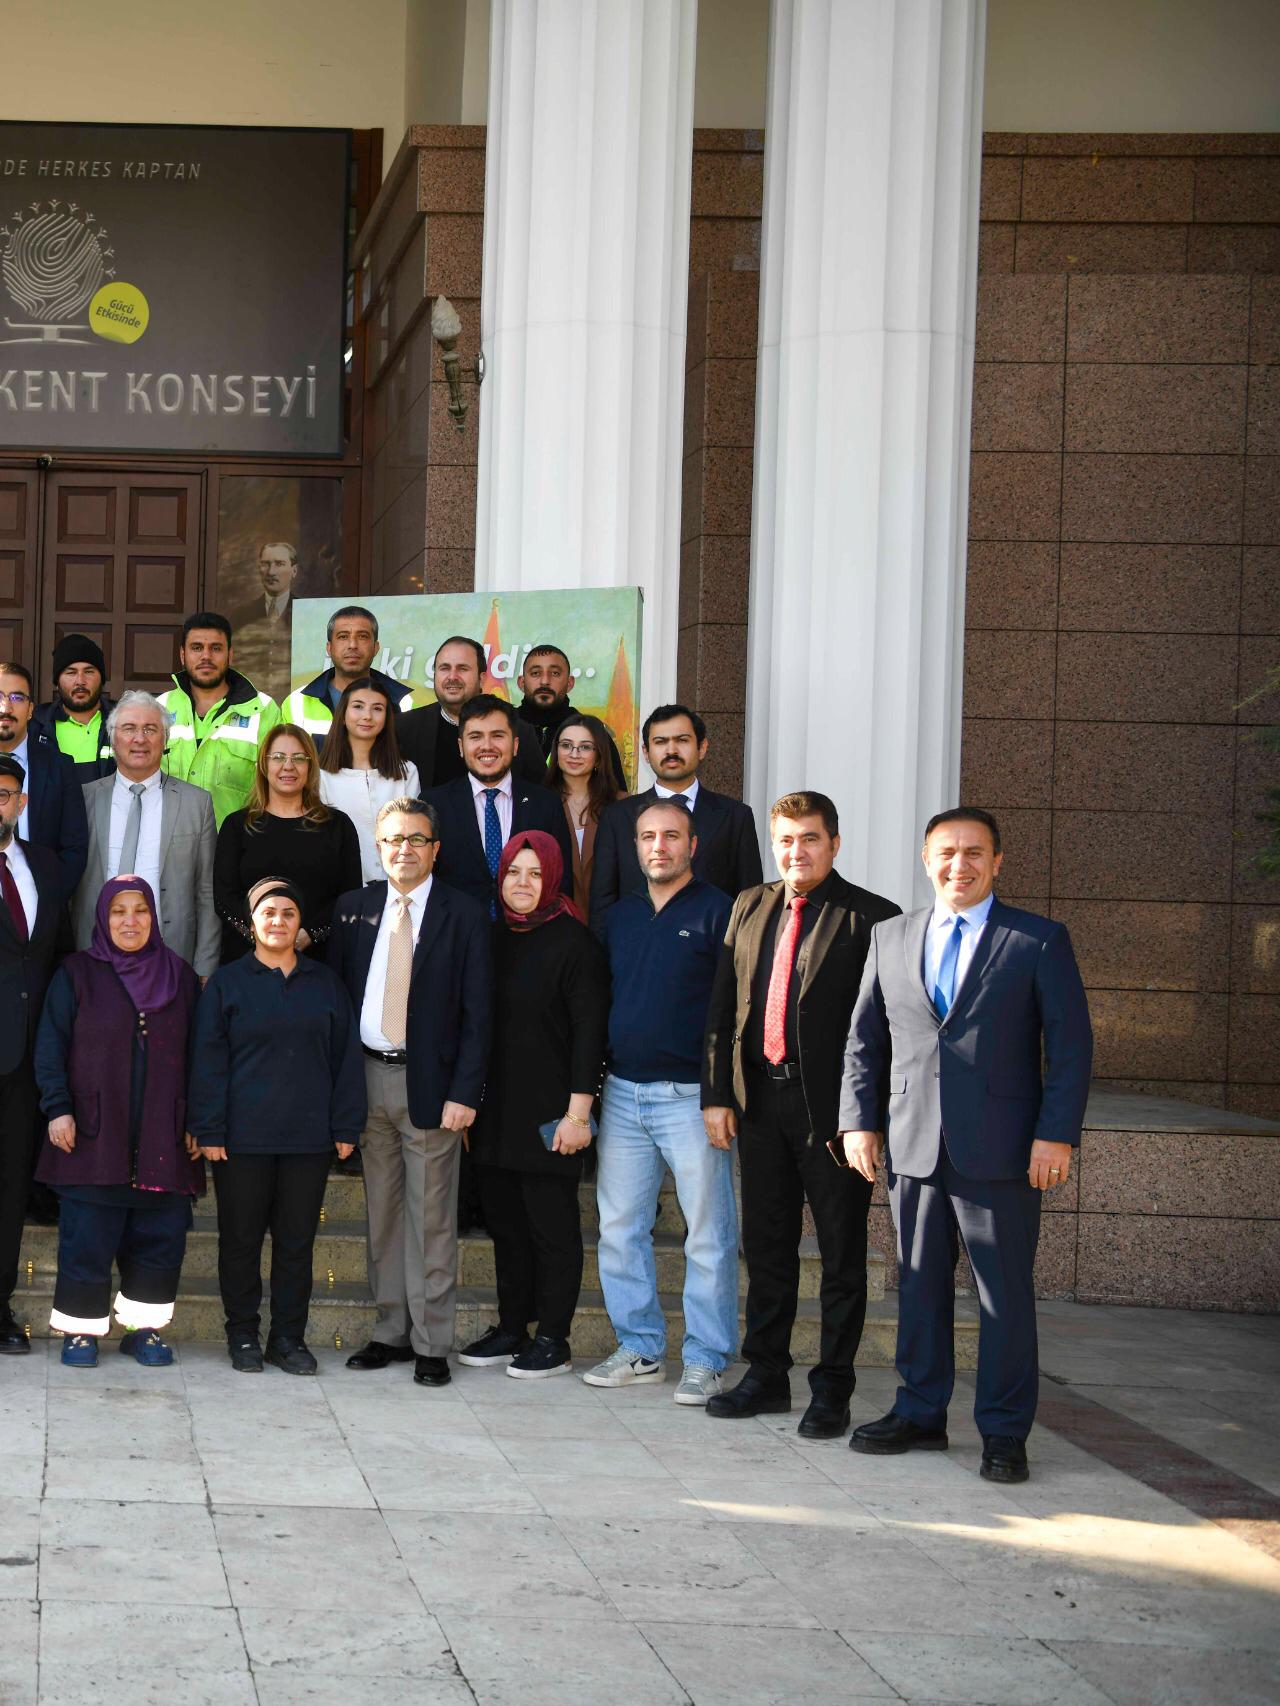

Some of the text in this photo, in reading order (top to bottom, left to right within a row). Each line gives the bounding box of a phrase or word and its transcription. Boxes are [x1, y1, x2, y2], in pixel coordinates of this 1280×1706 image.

[38, 160, 112, 178] HERKES
[122, 162, 201, 180] KAPTAN
[96, 305, 141, 328] Etkisinde
[110, 299, 134, 314] Gücü
[126, 365, 316, 418] KONSEYİ
